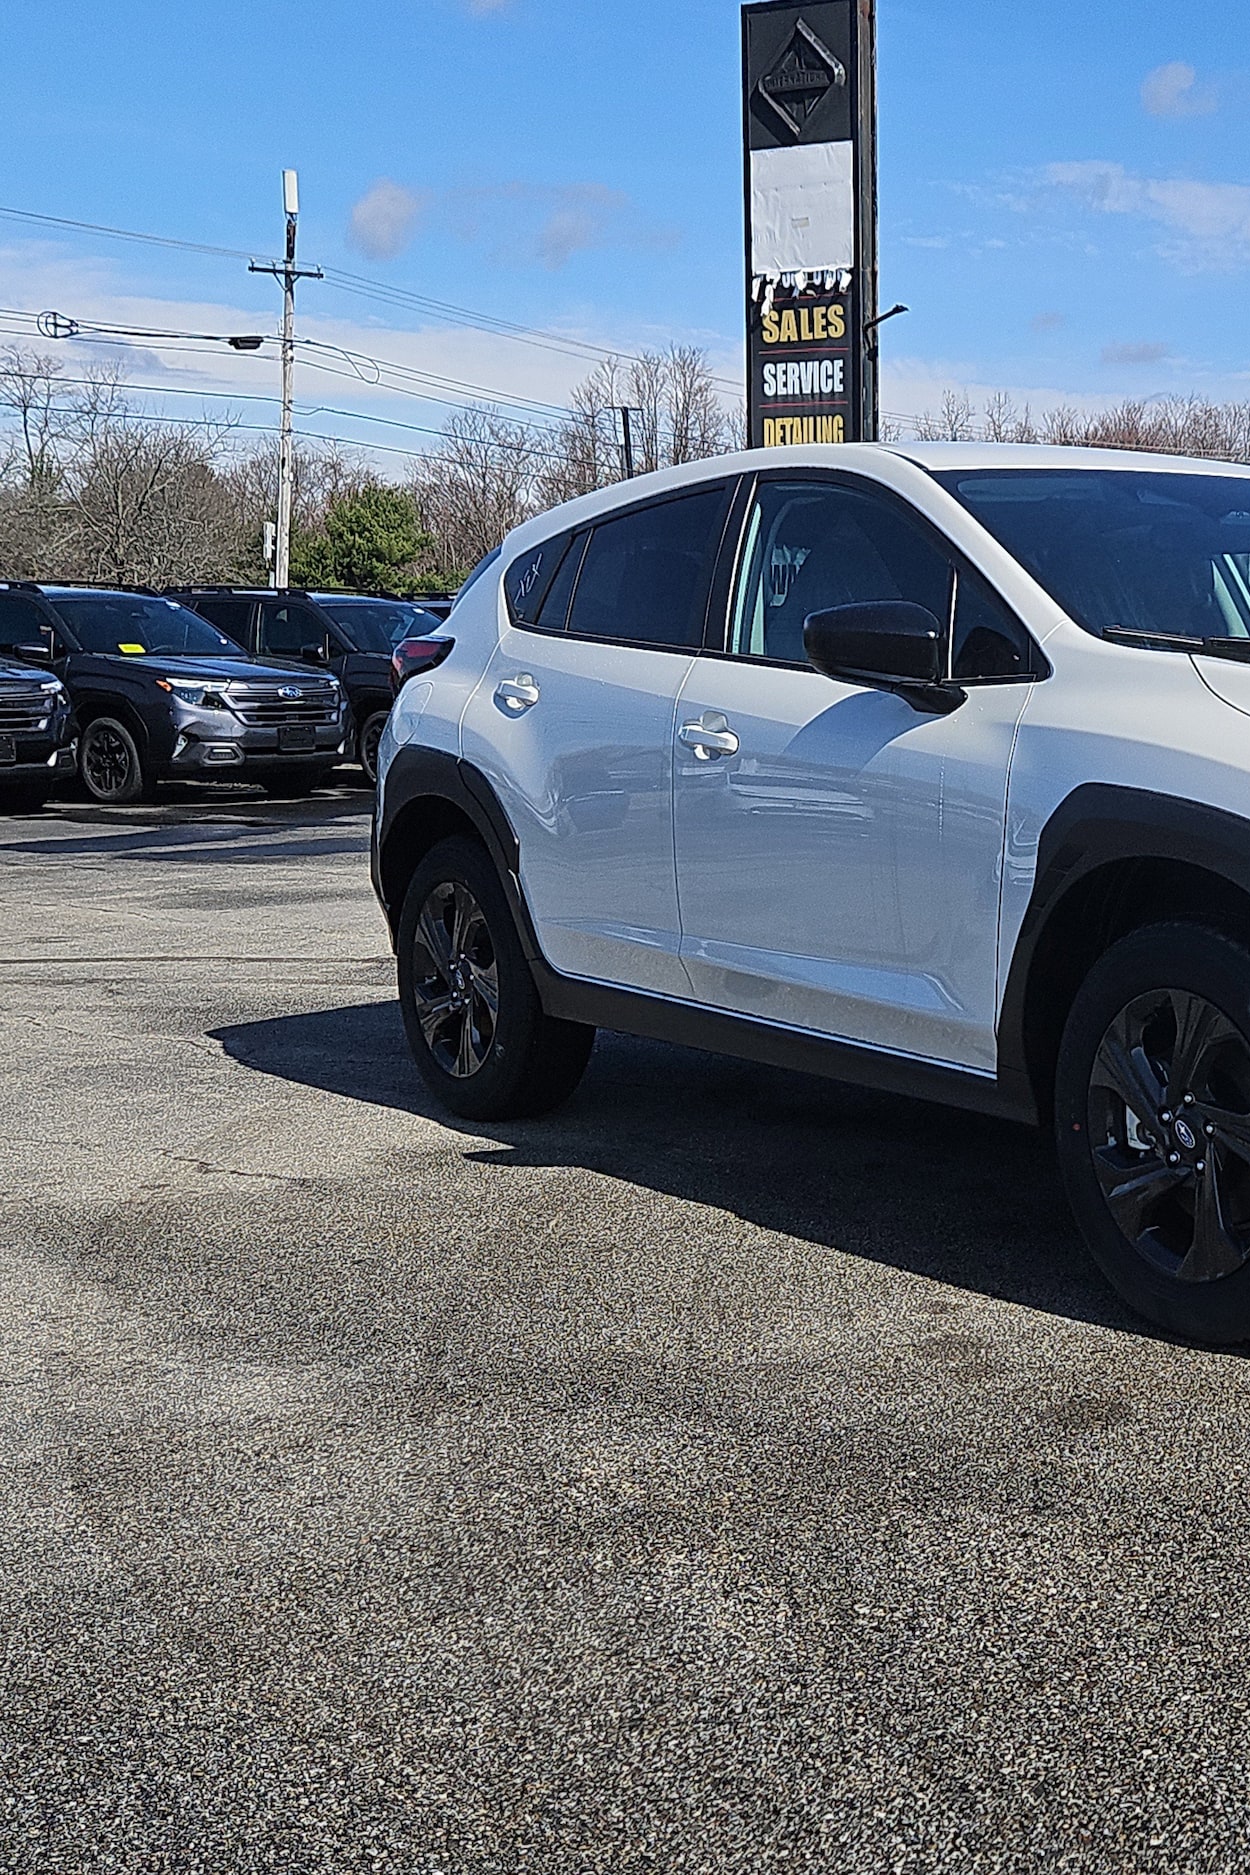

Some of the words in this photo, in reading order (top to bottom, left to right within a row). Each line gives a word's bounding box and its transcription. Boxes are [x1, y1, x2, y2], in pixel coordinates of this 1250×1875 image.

[762, 303, 845, 344] SALES
[763, 359, 844, 397] SERVICE
[763, 414, 844, 448] DETAILING
